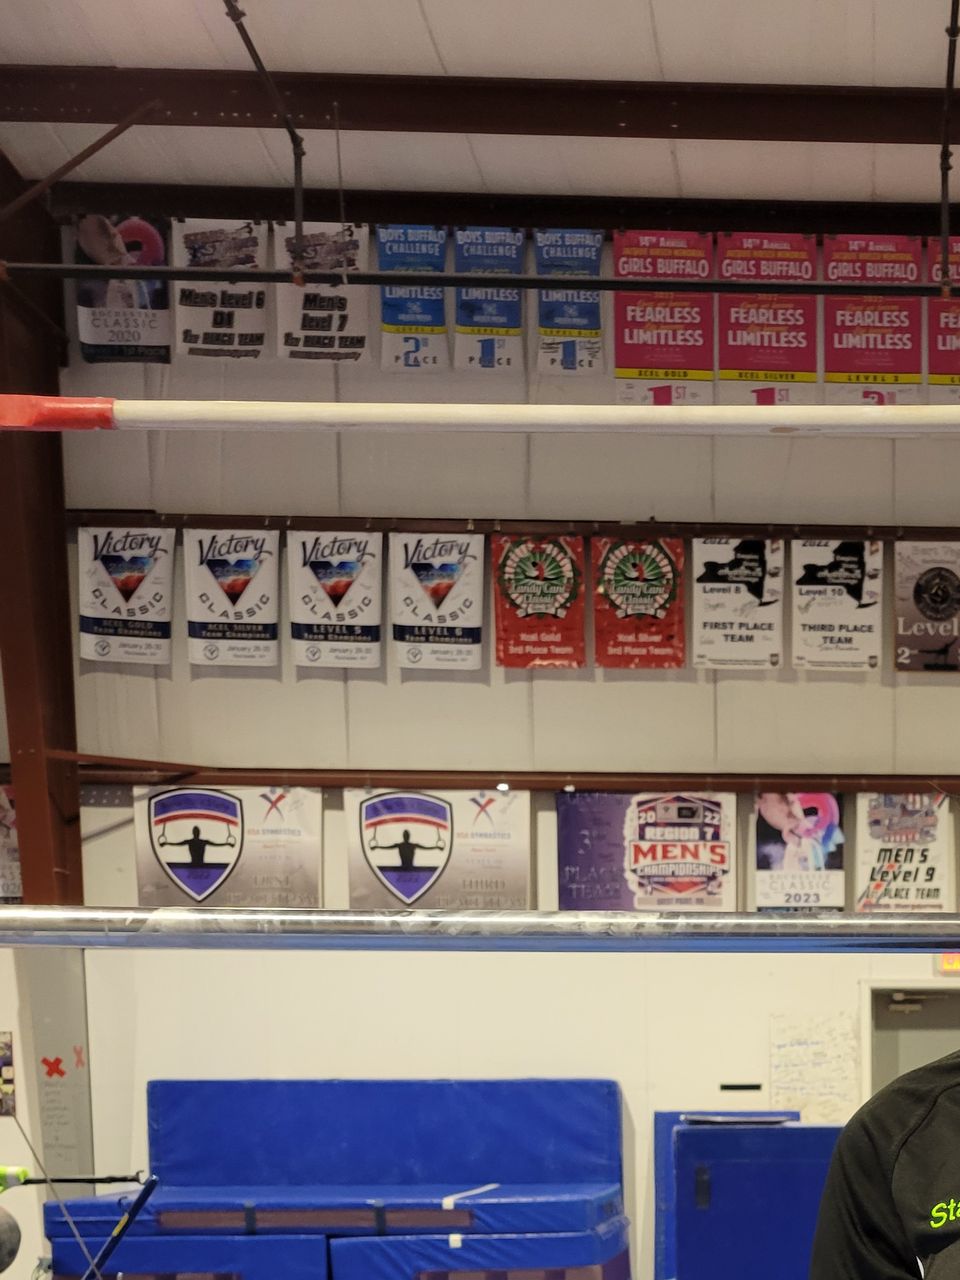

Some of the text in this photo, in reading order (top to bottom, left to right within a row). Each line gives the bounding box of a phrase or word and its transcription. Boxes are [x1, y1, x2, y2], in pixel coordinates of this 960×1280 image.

[379, 228, 447, 244] BOYS BUFFALO
[456, 230, 524, 246] BOYS BUFFALO
[536, 232, 602, 247] BOYS BUFFALO
[385, 242, 441, 256] CHALLENGE
[463, 244, 517, 258] CHALLENGE
[542, 246, 597, 260] CHALLENGE
[618, 257, 709, 277] GIRLS BUFFALO
[722, 259, 812, 279] GIRLS BUFFALO
[828, 262, 918, 281] GIRLS BUFFALO
[385, 287, 443, 300] LIMITLESS
[461, 288, 520, 301] LIMITLESS
[541, 290, 600, 303] LIMITLESS
[626, 306, 700, 324] FEARLESS
[730, 307, 804, 325] FEARLESS
[836, 311, 910, 327] FEARLESS
[91, 317, 158, 330] CLASSIC
[108, 330, 141, 343] 2020
[624, 328, 704, 346] LIMITLESS
[727, 330, 807, 347] LIMITLESS
[833, 332, 912, 349] LIMITLESS
[92, 530, 168, 562] Victory
[198, 534, 273, 566] Victory
[301, 536, 376, 567] Victory
[404, 538, 477, 569] Victory
[702, 586, 731, 594] Level
[798, 588, 844, 597] Level 10
[91, 588, 163, 617] CLASSIC
[198, 592, 270, 620] CLASSIC
[301, 595, 372, 622] CLASSIC
[403, 596, 473, 624] CLASSIC
[313, 624, 346, 634] LEVEL
[414, 627, 449, 636] LEVEL
[702, 621, 775, 632] FIRST PLACE
[801, 624, 875, 634] THIRD PLACE
[897, 617, 960, 637] Level
[540, 632, 561, 642] Gold
[722, 634, 755, 643] TEAM
[821, 636, 854, 645] TEAM
[551, 646, 574, 655] Team
[638, 810, 720, 826] 20 22
[644, 826, 715, 841] REGION 7
[633, 842, 727, 865] MEN'S
[870, 867, 936, 882] Level 9
[784, 892, 821, 904] 2023
[883, 887, 941, 899] PLACE TEAM
